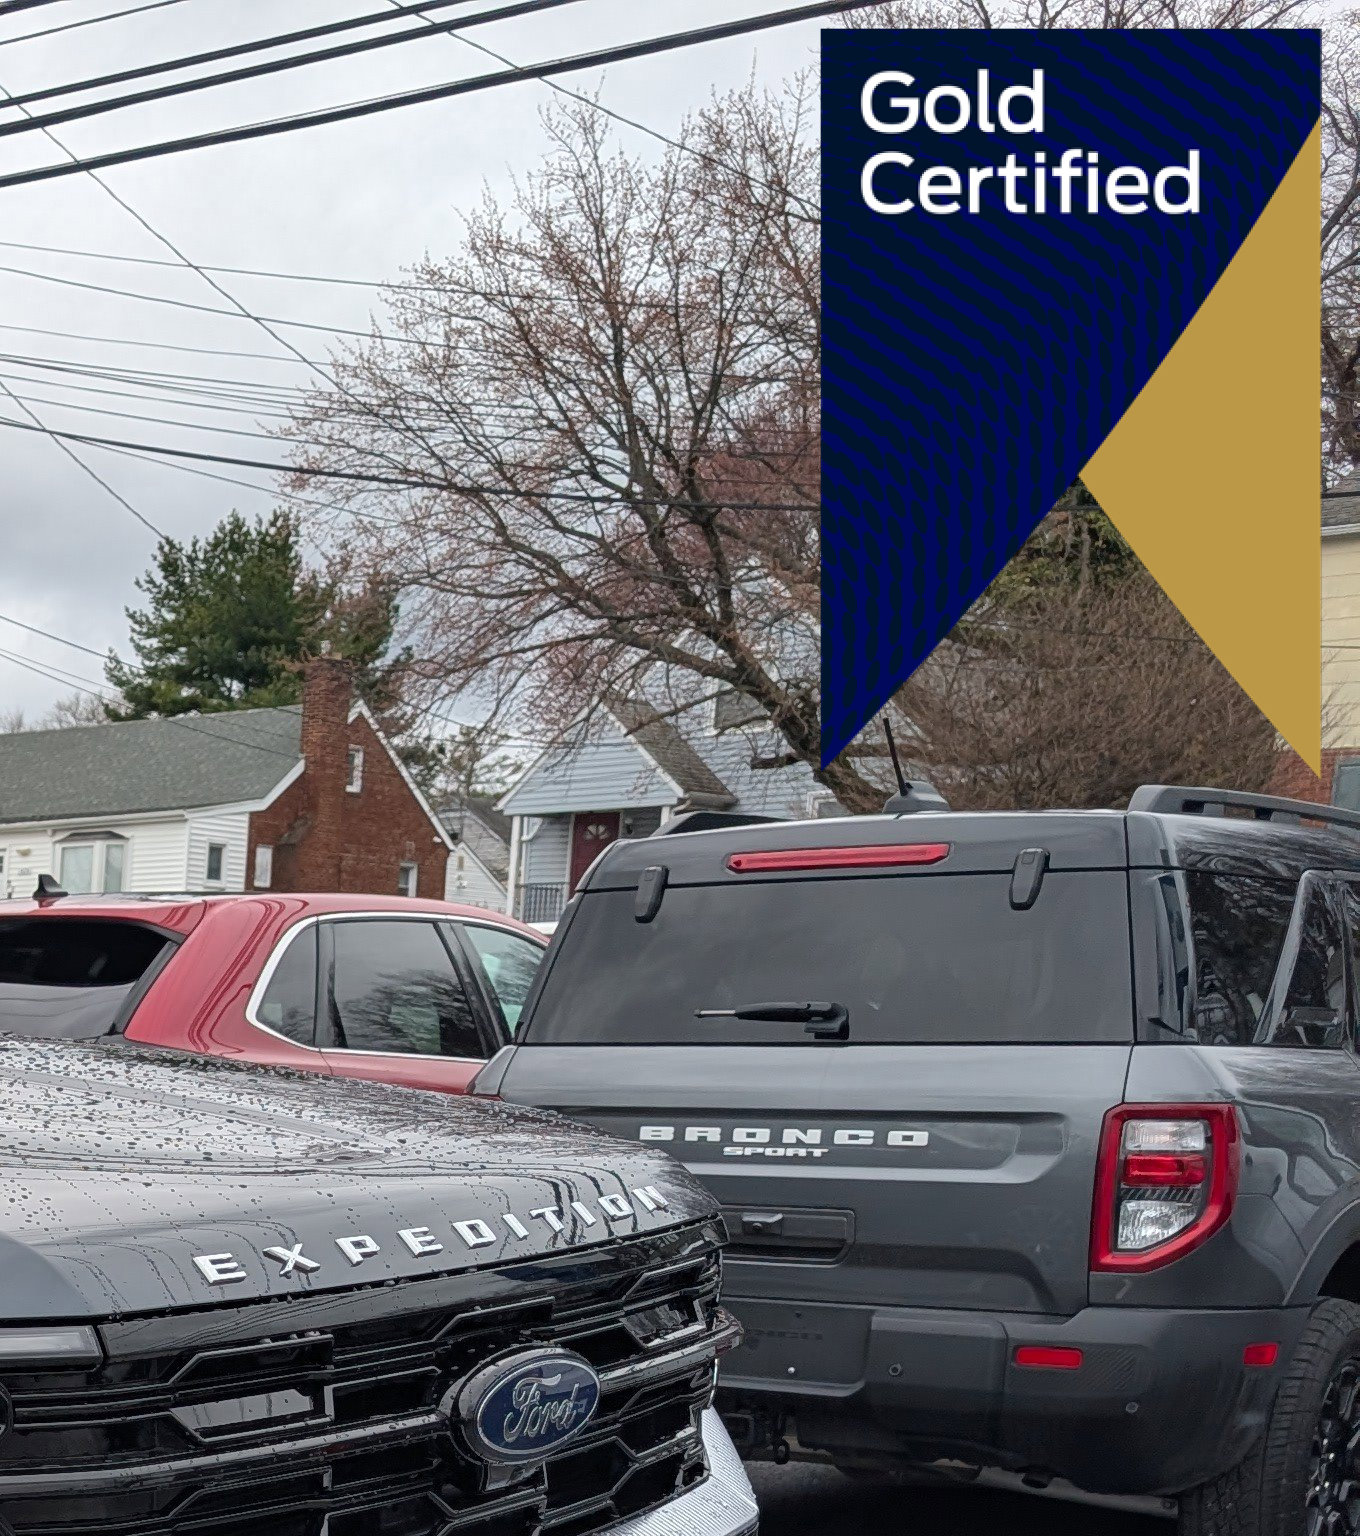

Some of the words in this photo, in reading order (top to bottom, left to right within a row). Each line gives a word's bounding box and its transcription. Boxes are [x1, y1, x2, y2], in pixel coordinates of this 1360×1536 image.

[638, 1125, 930, 1147] BRONCO
[723, 1146, 829, 1157] SPORT
[192, 1185, 672, 1285] EXPEDITION
[503, 1372, 587, 1445] Ford
